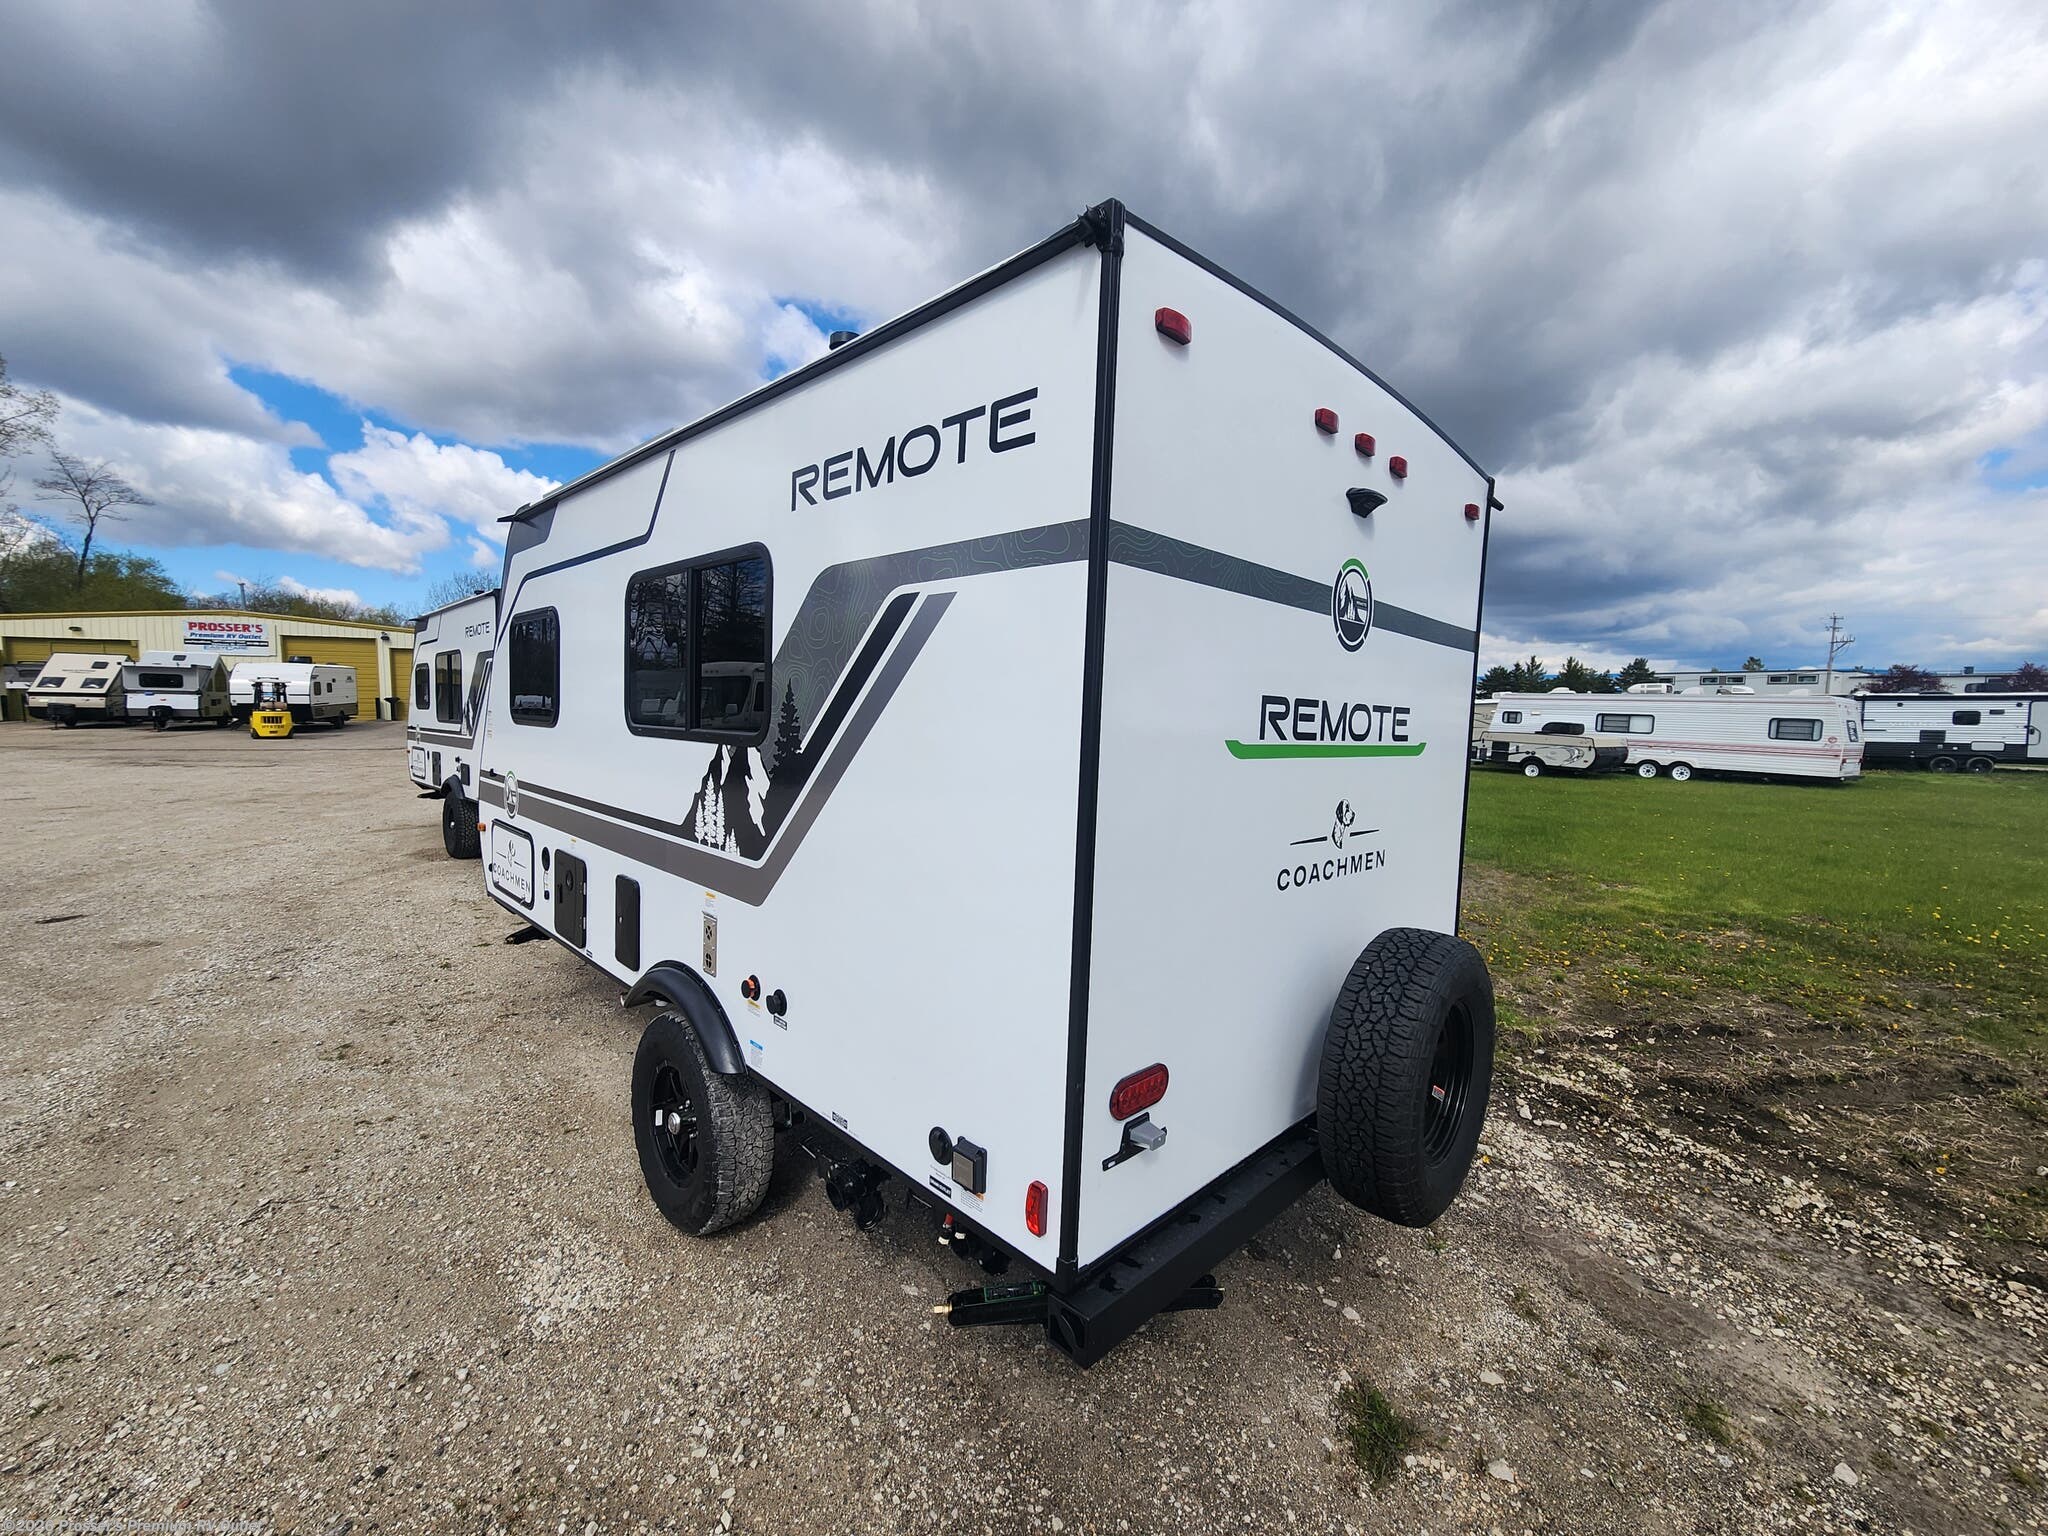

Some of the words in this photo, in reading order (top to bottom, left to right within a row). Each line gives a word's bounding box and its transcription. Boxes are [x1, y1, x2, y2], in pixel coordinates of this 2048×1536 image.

[791, 386, 1039, 513] REMOTE
[188, 621, 264, 633] PROSSER'S
[464, 620, 491, 639] REMOTE
[1259, 695, 1411, 742] REMOTE
[492, 862, 531, 893] COACHMEN
[1277, 849, 1386, 892] COACHMEN
